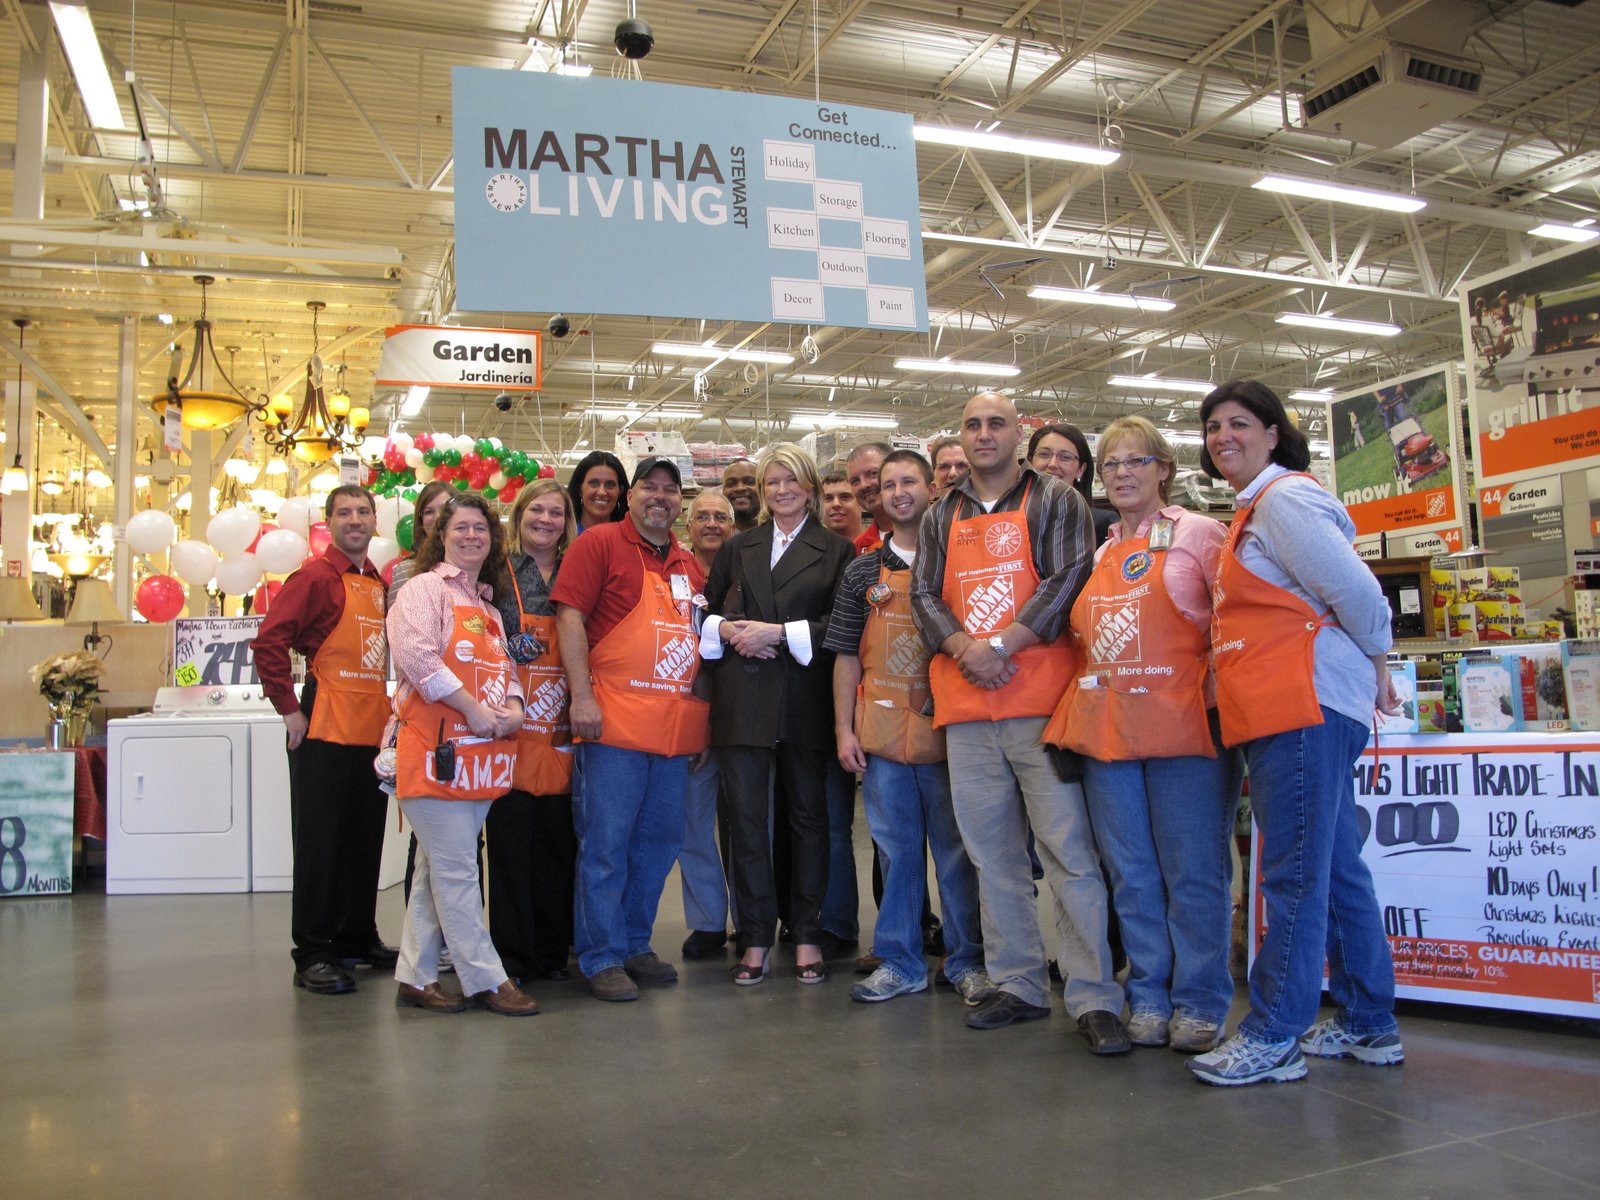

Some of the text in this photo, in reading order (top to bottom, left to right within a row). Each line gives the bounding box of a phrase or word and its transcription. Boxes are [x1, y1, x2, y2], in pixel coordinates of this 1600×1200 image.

[817, 107, 849, 127] Get
[788, 122, 897, 150] Connected...
[484, 127, 725, 184] MARTHA
[769, 155, 811, 172] Holiday
[729, 146, 749, 229] STEWART
[530, 173, 729, 225] LIVING
[819, 194, 858, 210] Storage
[773, 223, 815, 239] Kitchen
[864, 232, 908, 249] Flooring
[821, 260, 864, 275] Outdoors
[783, 293, 813, 306] Decor
[879, 298, 903, 312] Paint
[432, 340, 532, 364] Garden
[459, 370, 532, 384] Jardinería
[1488, 385, 1583, 441] grill it
[1553, 430, 1598, 445] You can do
[1570, 442, 1583, 450] We
[1343, 473, 1413, 507] mow it
[1482, 488, 1547, 504] 44 Garden
[1414, 531, 1459, 549] Garden 44
[999, 561, 1022, 572] FIRST
[964, 576, 1013, 634] HOME
[966, 584, 986, 607] THE
[982, 594, 1015, 632] DEPOT
[1094, 611, 1113, 634] THE
[891, 630, 912, 649] THE
[1091, 602, 1140, 663] HOME
[1105, 622, 1139, 662] DEPOT
[662, 636, 681, 654] THE
[340, 670, 359, 678] More
[1117, 667, 1142, 676] More
[533, 679, 554, 698] THE
[630, 679, 650, 688] More
[651, 682, 677, 693] saving.
[522, 722, 549, 734] saving.
[1547, 721, 1564, 729] LED
[1488, 811, 1518, 838] LED
[1384, 905, 1431, 939] OFF
[1483, 902, 1547, 924] Christmas
[1477, 925, 1549, 952] Recycling
[1557, 930, 1600, 952] Event
